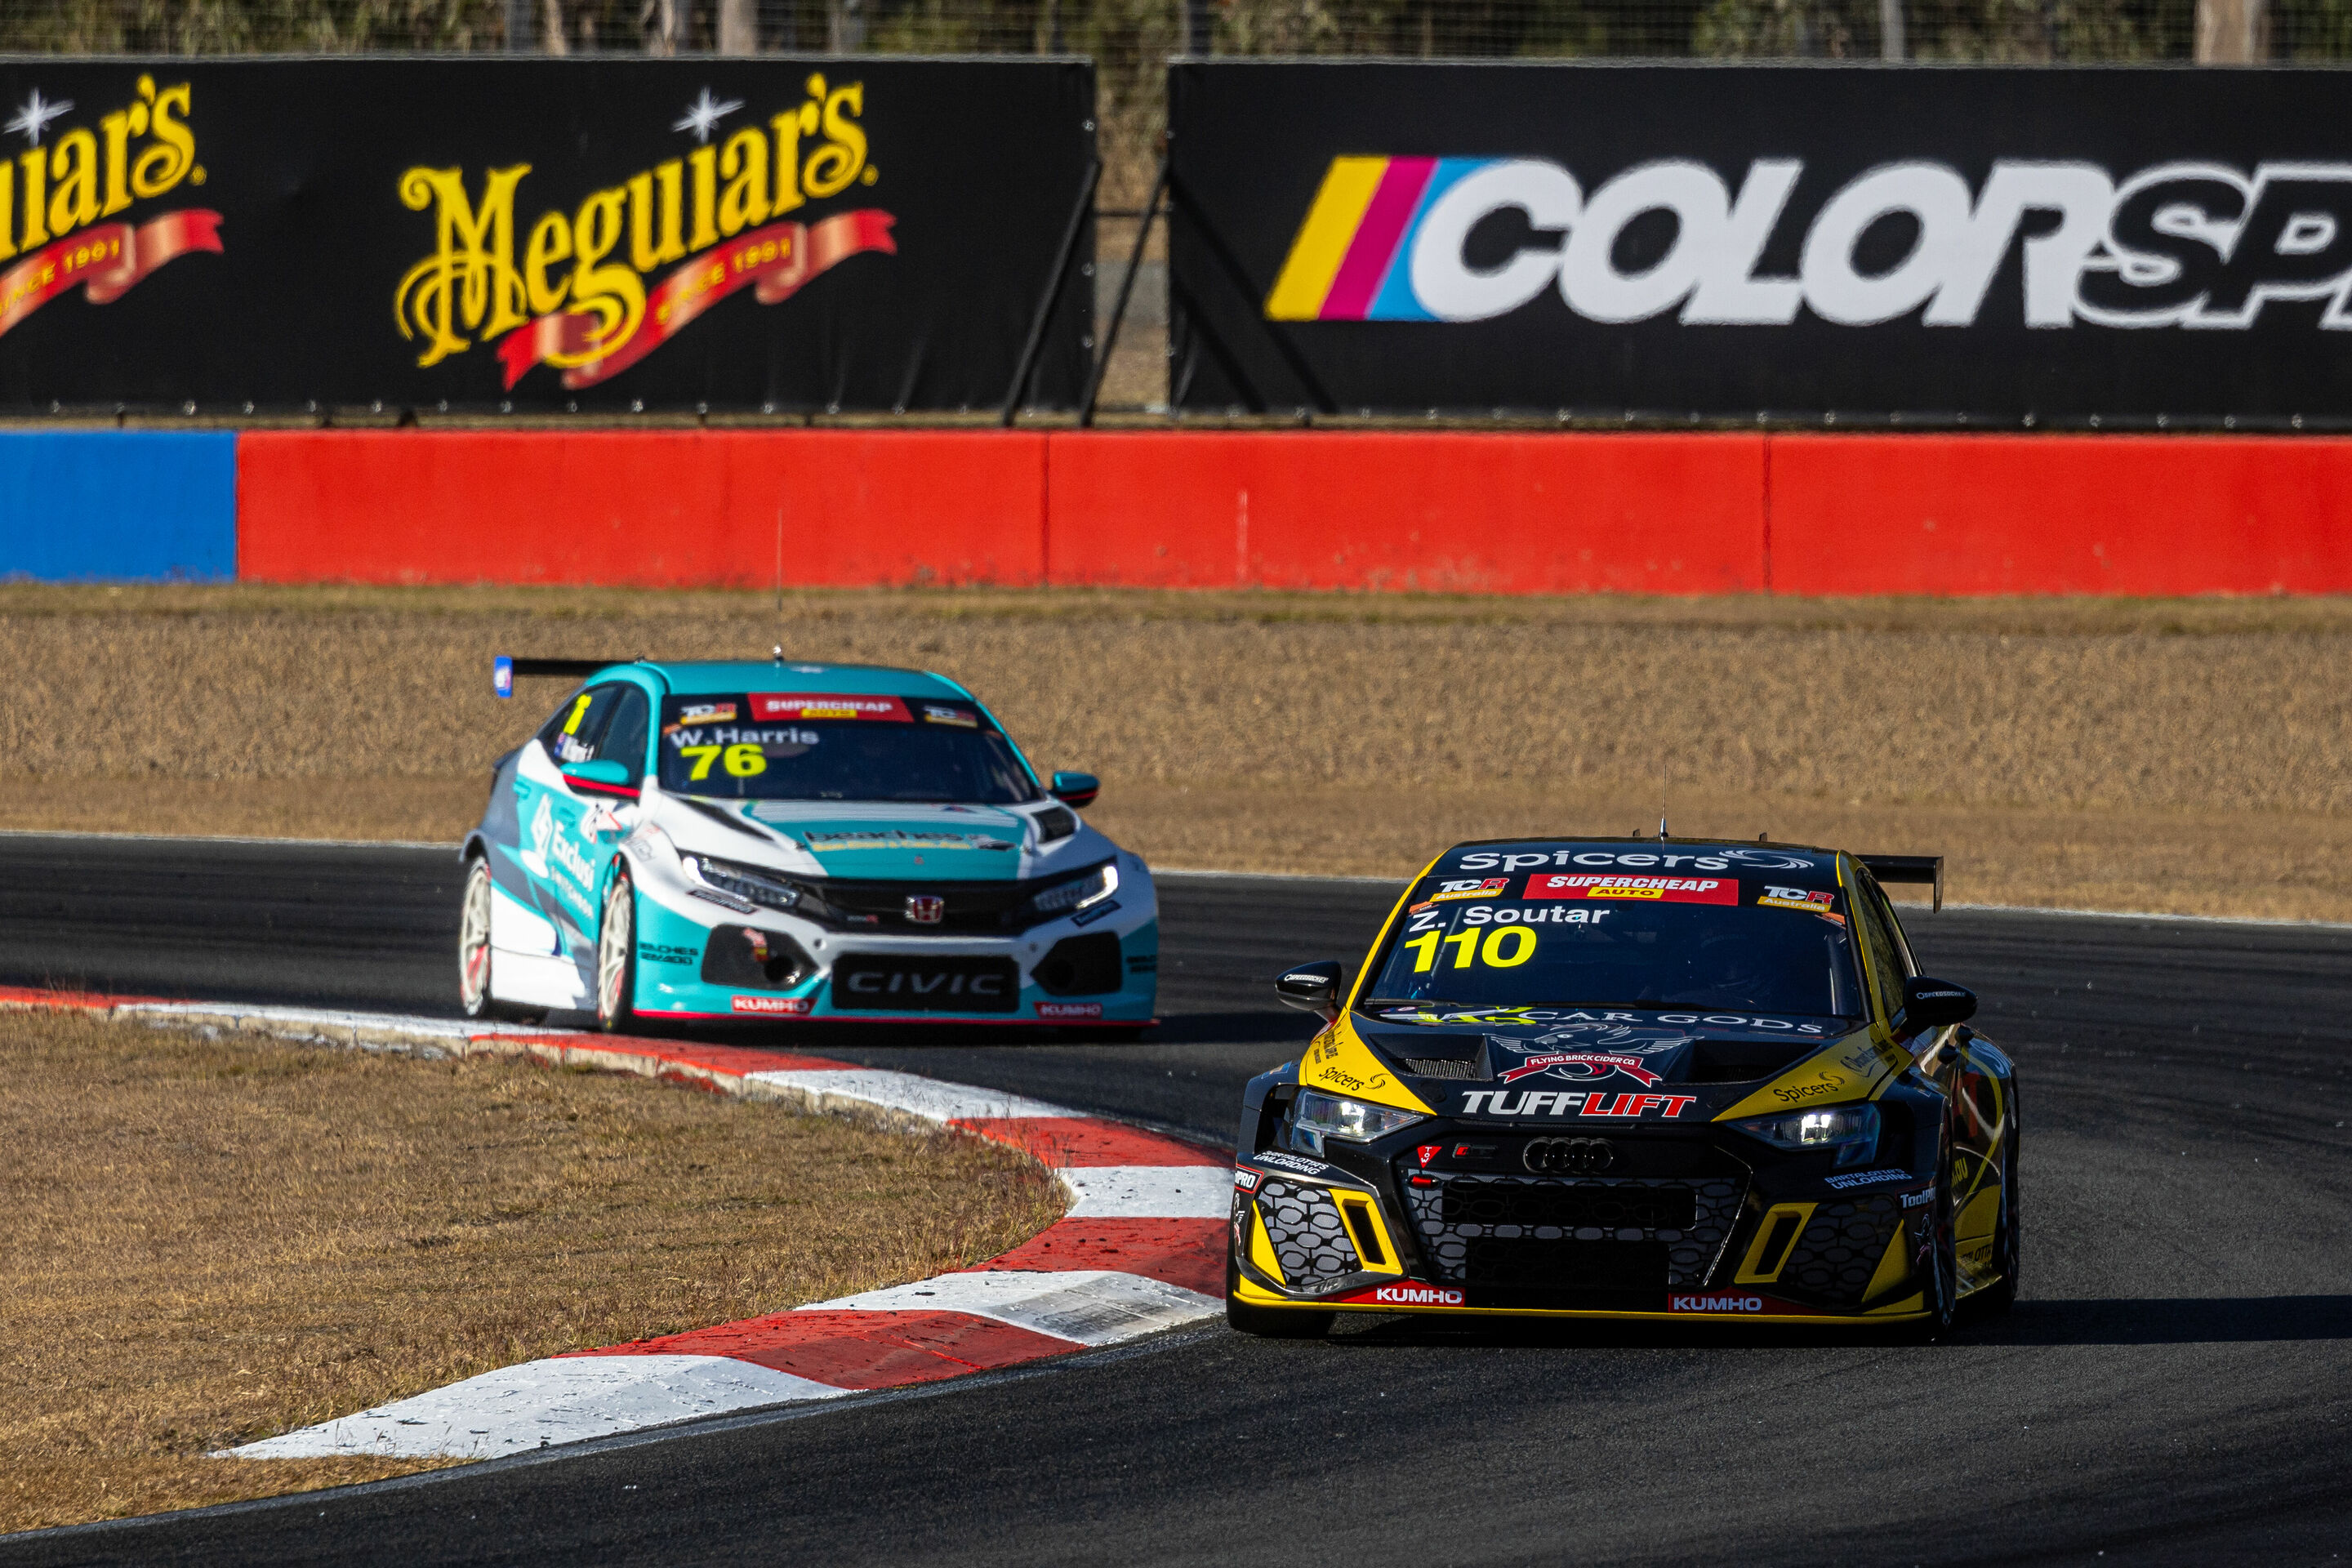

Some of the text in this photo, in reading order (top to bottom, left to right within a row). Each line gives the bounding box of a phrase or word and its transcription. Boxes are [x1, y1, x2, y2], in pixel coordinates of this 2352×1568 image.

[395, 72, 869, 369] Meguiar's
[1408, 154, 2352, 329] COLORSP
[765, 699, 893, 712] SUPERCHEAP
[680, 743, 768, 782] 76
[1459, 850, 1729, 872] Spicers
[1440, 878, 1509, 893] TCR
[1547, 875, 1719, 892] SUPERCHEAP
[1595, 888, 1655, 897] AUTO
[1436, 889, 1497, 900] Australia
[1764, 885, 1834, 906] TCR
[1764, 898, 1825, 911] Australia
[1409, 905, 1610, 932] Z. Soutar
[1405, 925, 1537, 973] 110
[847, 971, 1001, 995] CIVIC
[734, 999, 809, 1013] KUMHO
[1518, 1012, 1823, 1033] CAR GODS
[1530, 1055, 1564, 1066] FLYING
[1593, 1055, 1623, 1063] CIDER
[1318, 1067, 1365, 1091] Spicers
[1773, 1082, 1838, 1103] Spicers
[1461, 1090, 1698, 1118] TUFFLIFT
[1253, 1154, 1321, 1174] UNLOADING
[1421, 1146, 1432, 1163] TOW
[1831, 1174, 1913, 1189] UNLOADING
[1376, 1288, 1463, 1303] KUMHO
[1673, 1297, 1762, 1312] KUMHO
